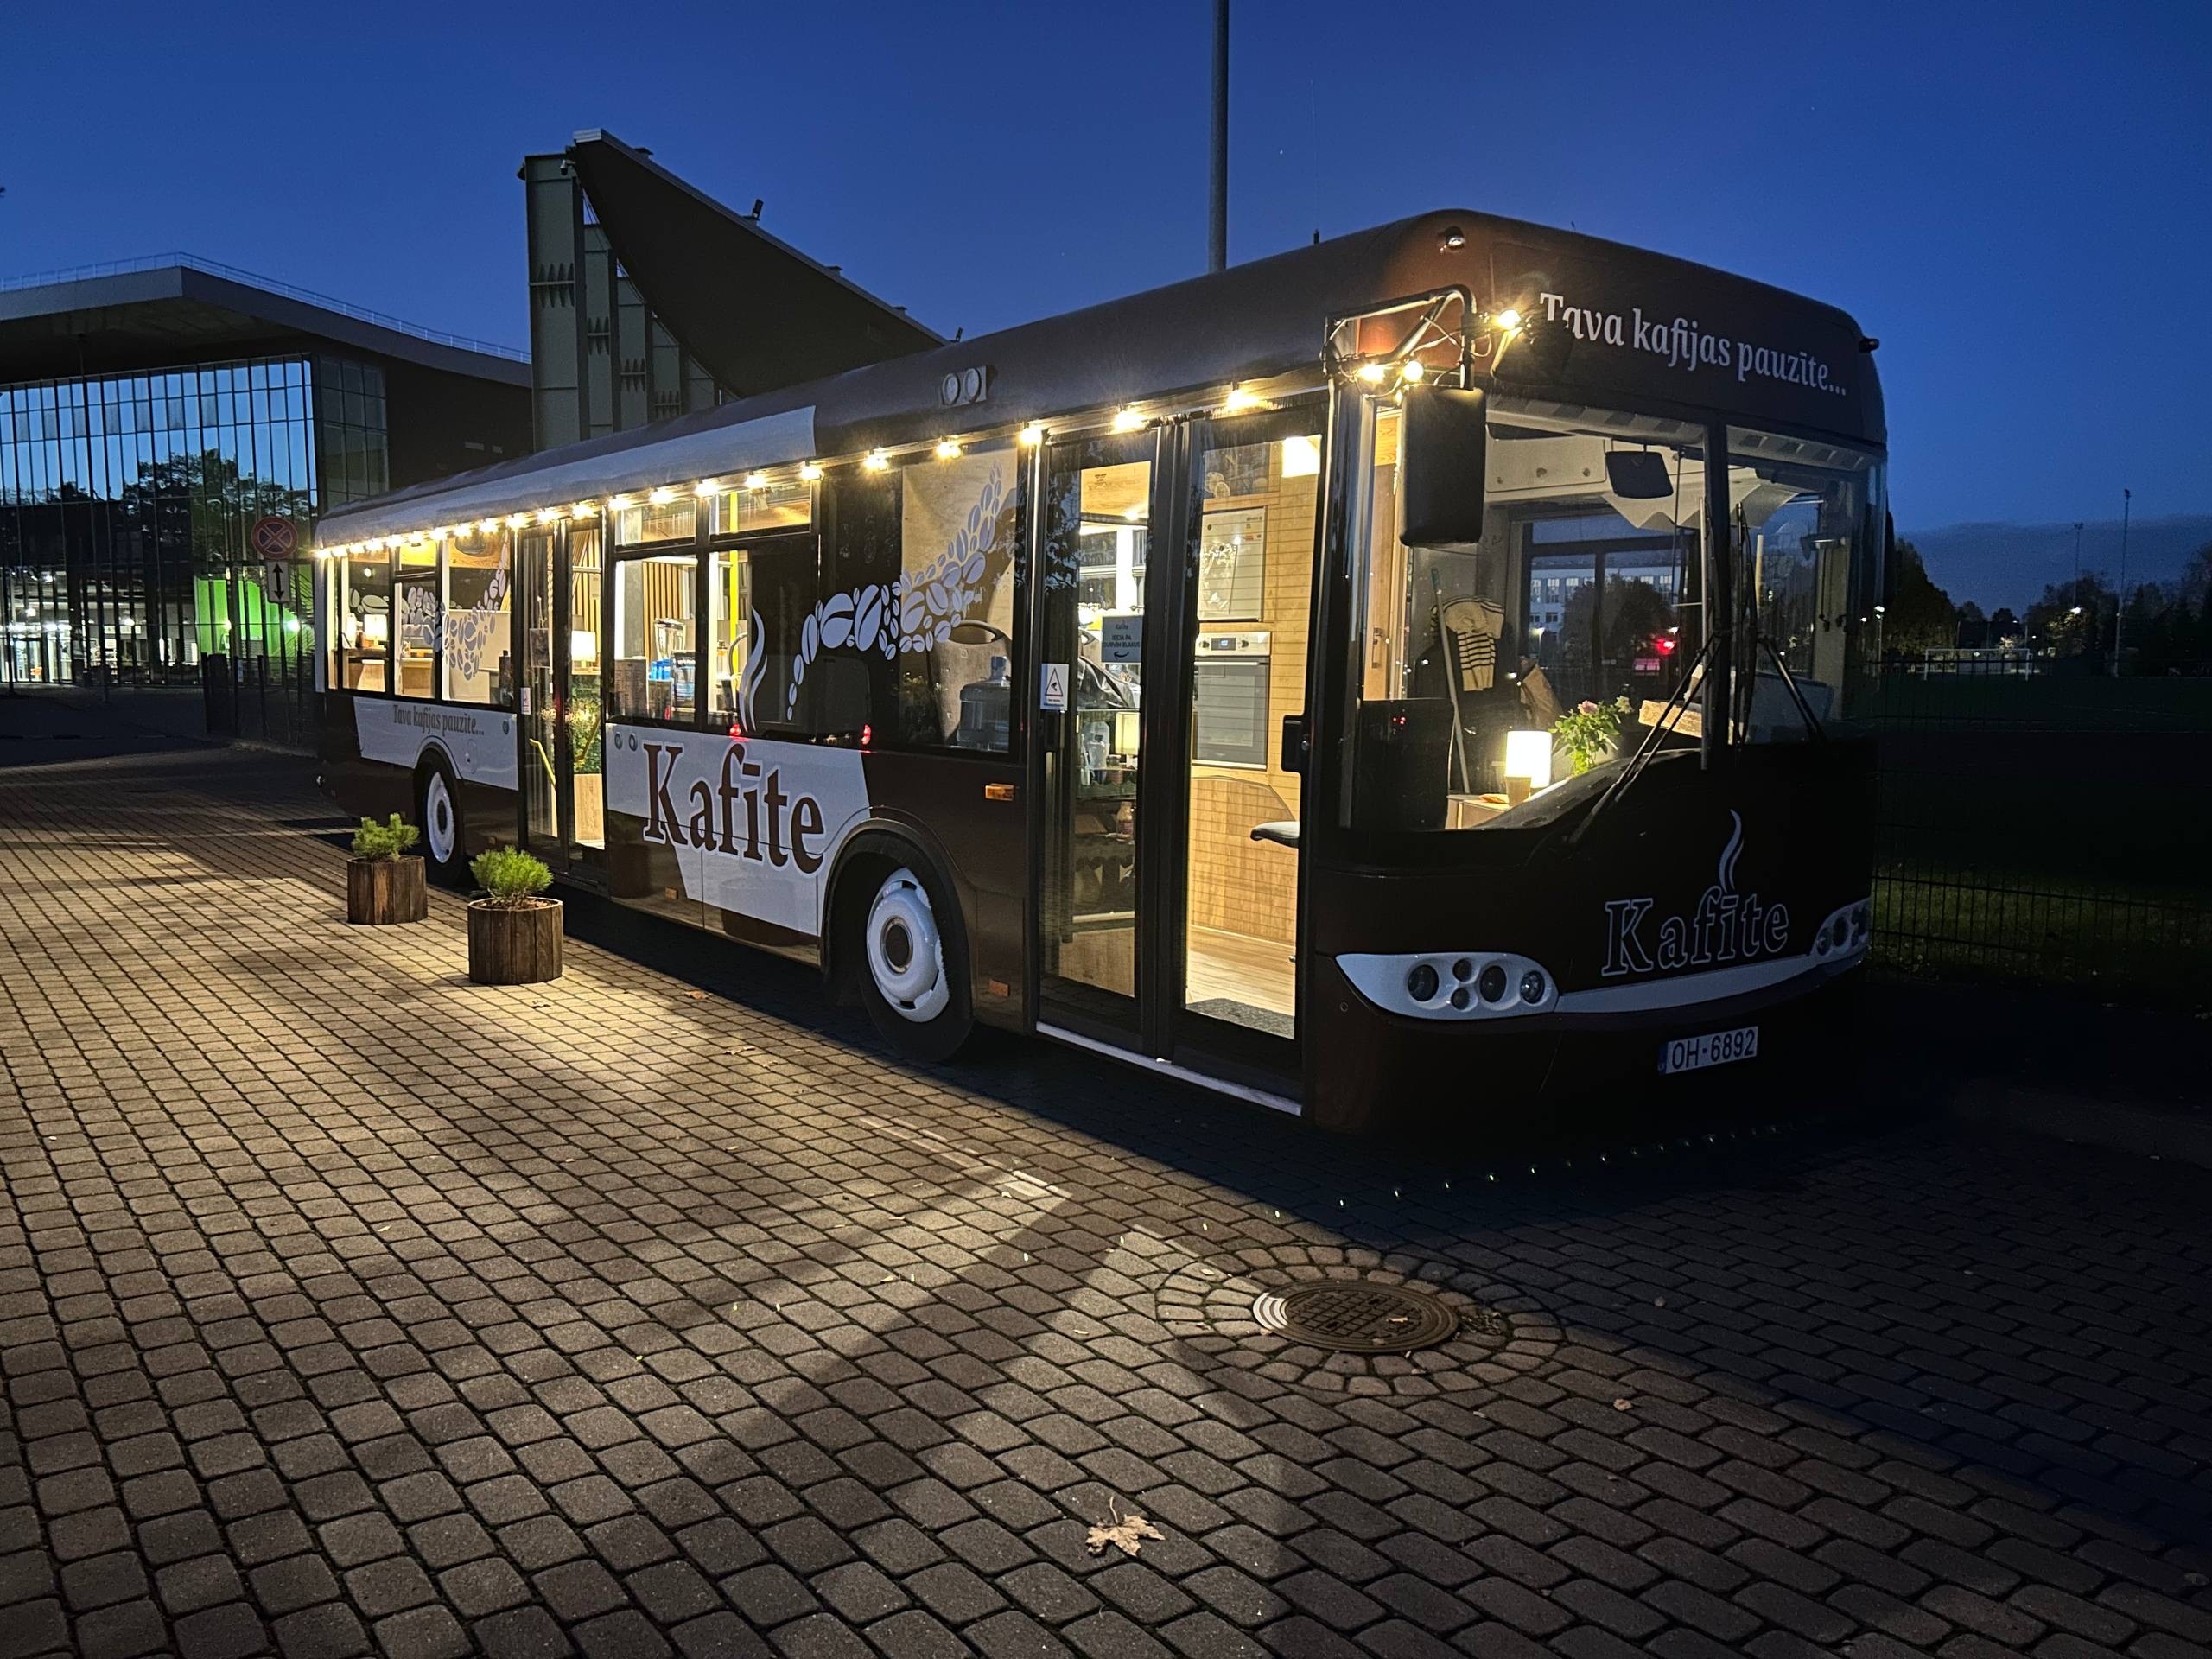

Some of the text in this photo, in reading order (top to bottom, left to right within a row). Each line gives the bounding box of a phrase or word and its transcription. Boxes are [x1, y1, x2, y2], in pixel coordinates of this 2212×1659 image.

[1539, 292, 1847, 396] Tava kafijas pauzīte...
[392, 704, 412, 726] Tava
[413, 705, 442, 734] kafijas
[641, 741, 826, 875] Kafīte
[1600, 885, 1789, 977] Kafīte
[1671, 1028, 1756, 1070] OH-6892
